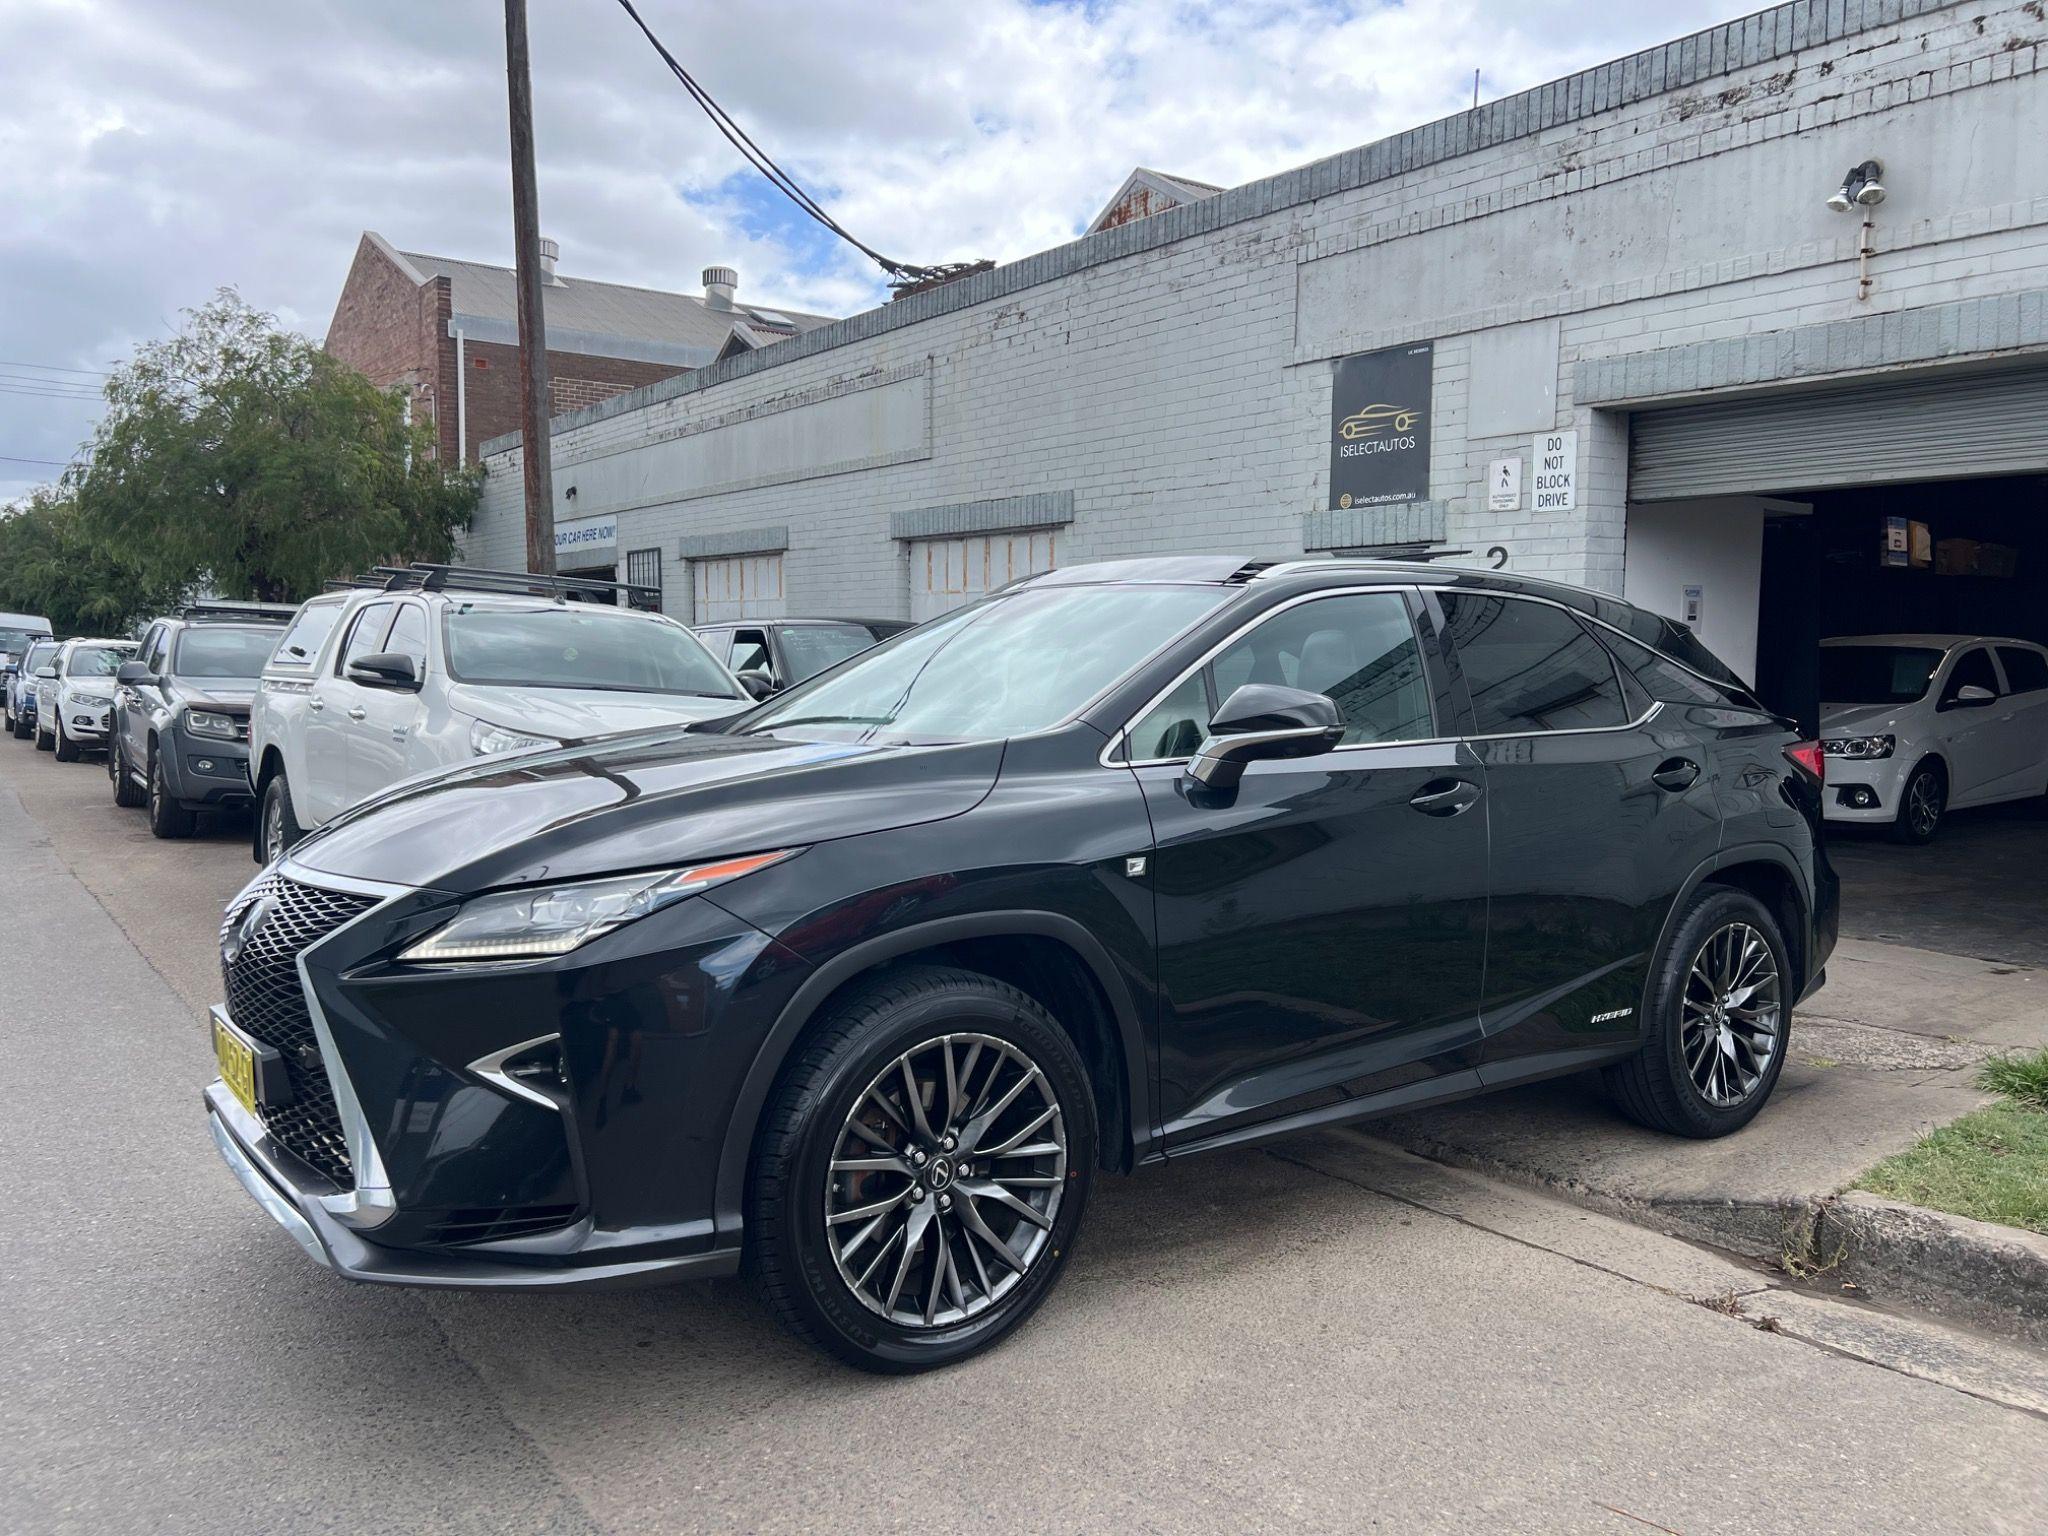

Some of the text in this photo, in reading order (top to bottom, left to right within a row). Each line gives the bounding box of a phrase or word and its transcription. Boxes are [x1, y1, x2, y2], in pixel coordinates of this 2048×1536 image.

[1340, 435, 1416, 458] ISELECTAUTOS
[1547, 437, 1562, 451] DO
[1544, 455, 1564, 470] NOT
[1536, 473, 1570, 490] BLOCK
[1354, 492, 1416, 504] iselectautos.com.au
[1538, 492, 1568, 508] DRIVE
[554, 533, 568, 546] OUR
[568, 530, 581, 544] CAR
[582, 528, 597, 542] HERE
[1487, 546, 1508, 569] 2
